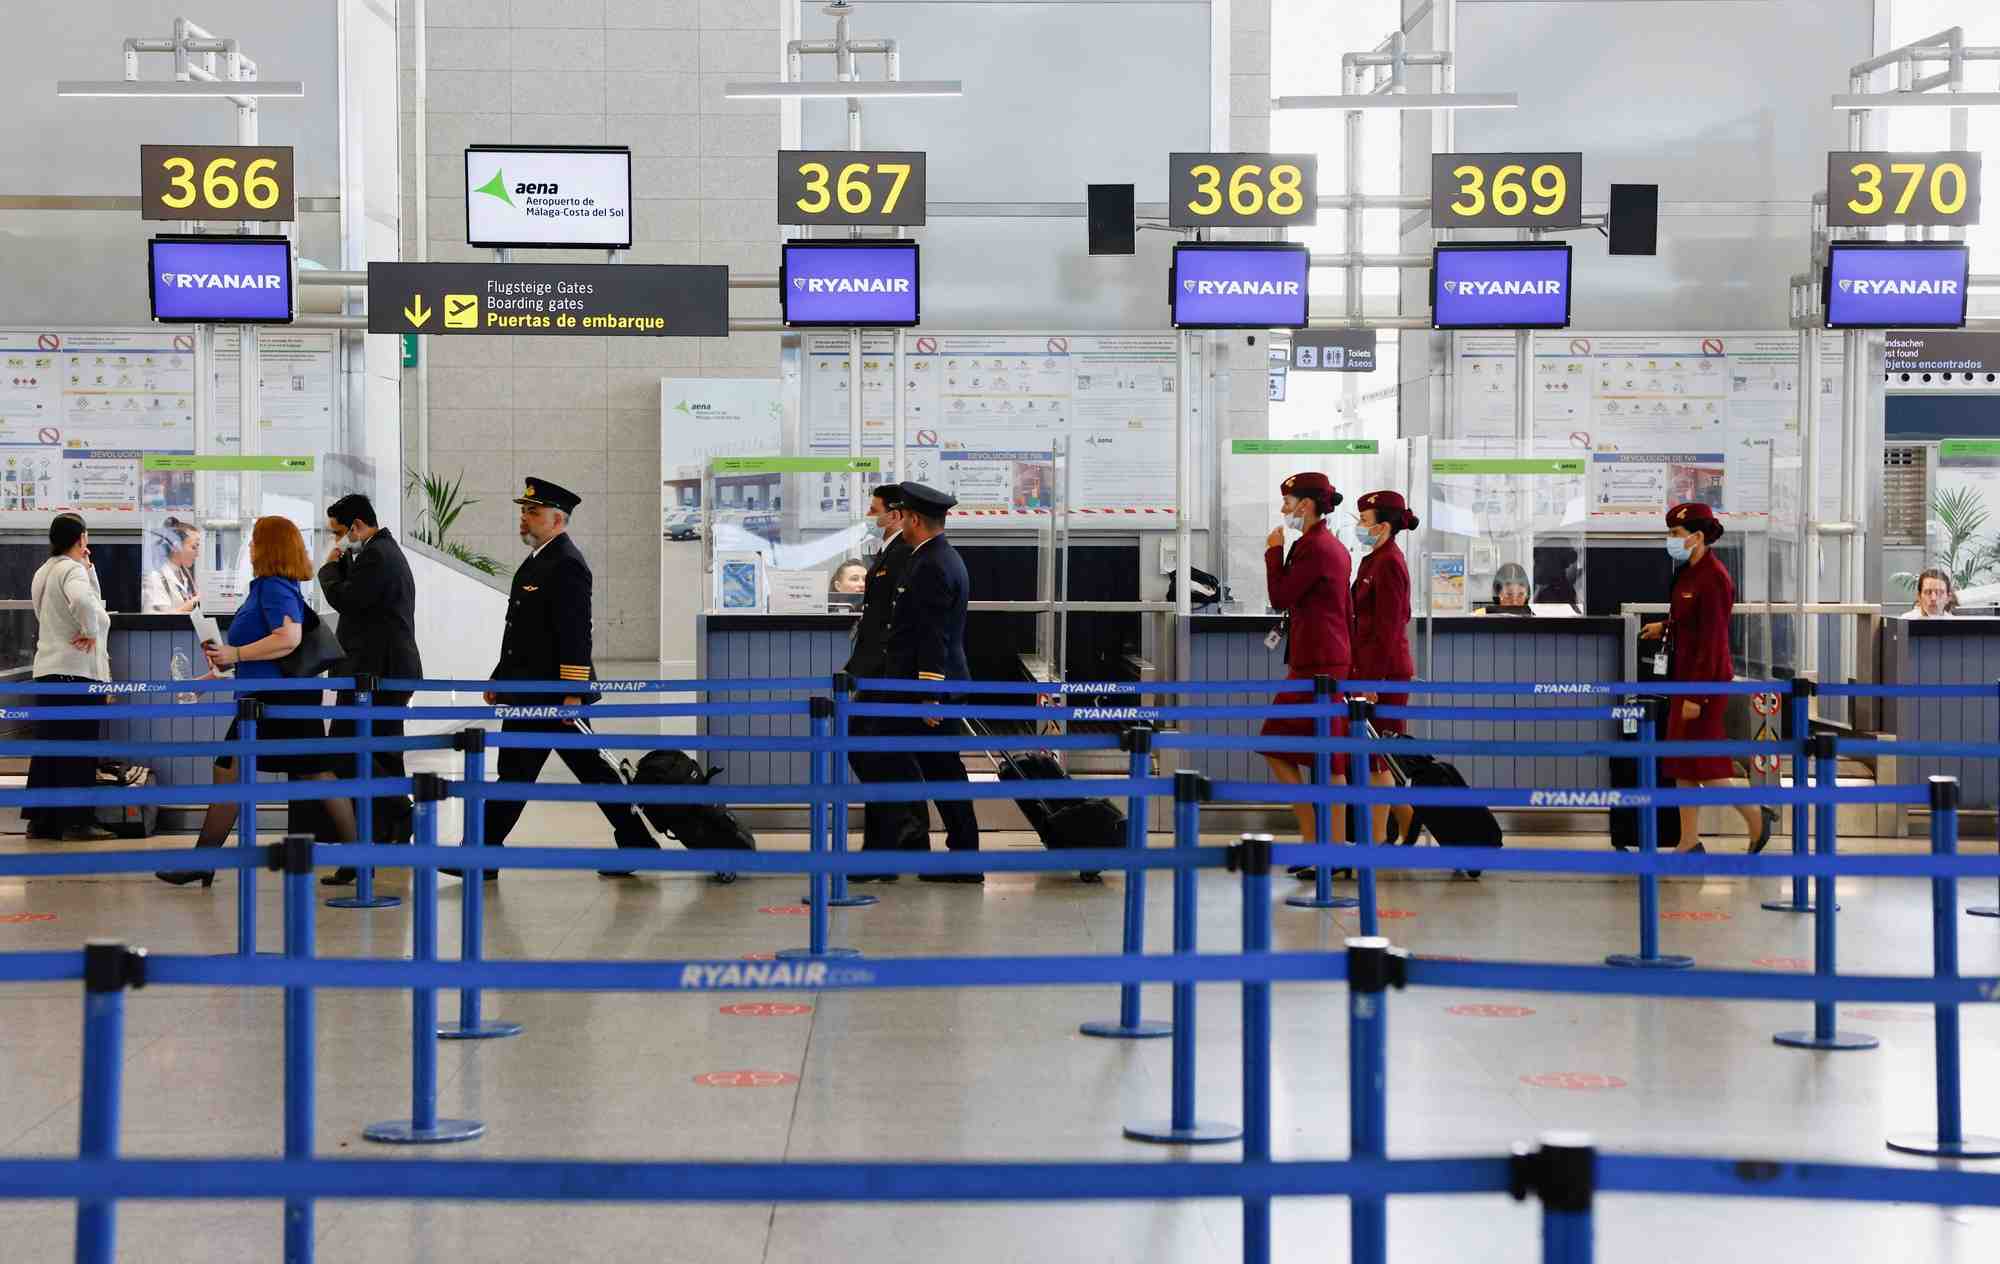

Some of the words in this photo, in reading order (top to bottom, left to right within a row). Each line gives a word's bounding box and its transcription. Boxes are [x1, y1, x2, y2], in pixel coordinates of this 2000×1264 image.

[161, 155, 280, 209] 366
[515, 182, 559, 195] aena
[797, 163, 912, 214] 367
[1189, 165, 1302, 215] 368
[1452, 165, 1567, 215] 369
[1847, 163, 1965, 214] 370
[526, 196, 579, 207] Aeropuerto
[583, 197, 595, 206] de
[526, 207, 590, 218] Málaga-Costa
[593, 208, 607, 217] del
[609, 208, 624, 217] Sol
[176, 273, 281, 289] RYANAIR
[487, 280, 552, 295] Flugsteige
[557, 281, 593, 294] Gates
[808, 278, 910, 293] RYANAIR
[1198, 279, 1299, 296] RYANAIR
[1458, 280, 1561, 296] RYANAIR
[1853, 279, 1958, 295] RYANAIR
[487, 296, 544, 311] Boarding
[548, 298, 584, 312] gates
[487, 312, 551, 328] Puertas
[556, 313, 576, 328] de
[582, 314, 665, 331] embarque
[1897, 348, 1920, 358] found
[1885, 360, 1917, 371] bjetos
[1918, 359, 1983, 369] encontrados
[691, 403, 712, 411] aena
